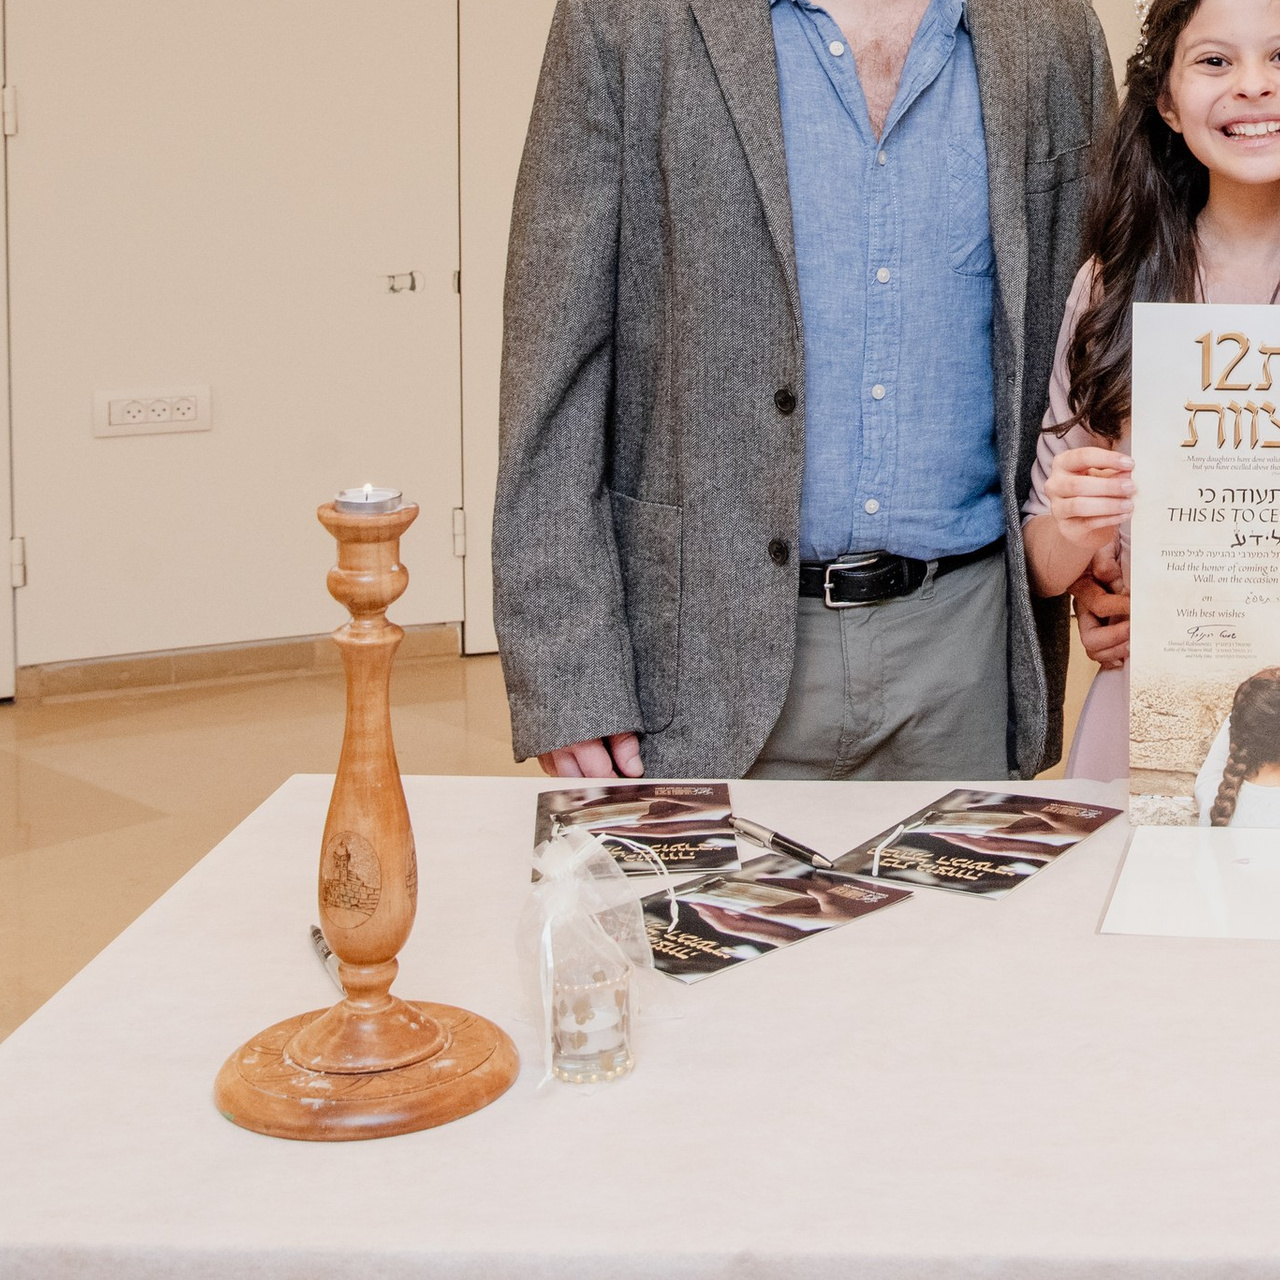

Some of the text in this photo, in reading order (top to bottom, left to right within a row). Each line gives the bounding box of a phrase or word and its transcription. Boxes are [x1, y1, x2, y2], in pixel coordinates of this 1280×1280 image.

[1194, 330, 1251, 391] 12
[1206, 455, 1236, 464] daughters
[1204, 464, 1215, 472] you
[1216, 463, 1230, 471] have
[1198, 488, 1216, 504] כי
[1167, 507, 1207, 522] THIS
[1211, 507, 1225, 522] IS
[1232, 507, 1255, 522] TO
[1160, 549, 1186, 557] מצוות
[1187, 549, 1204, 558] לגיל
[1206, 550, 1236, 559] בהגיעה
[1237, 551, 1269, 559] המערבי
[1166, 562, 1186, 571] Had
[1187, 562, 1200, 571] the
[1201, 562, 1225, 572] honor
[1227, 562, 1238, 575] of
[1238, 563, 1268, 576] coming
[1269, 565, 1278, 573] to
[1230, 574, 1242, 583] the
[1244, 576, 1278, 584] occasion
[1176, 608, 1246, 619] With best wishes
